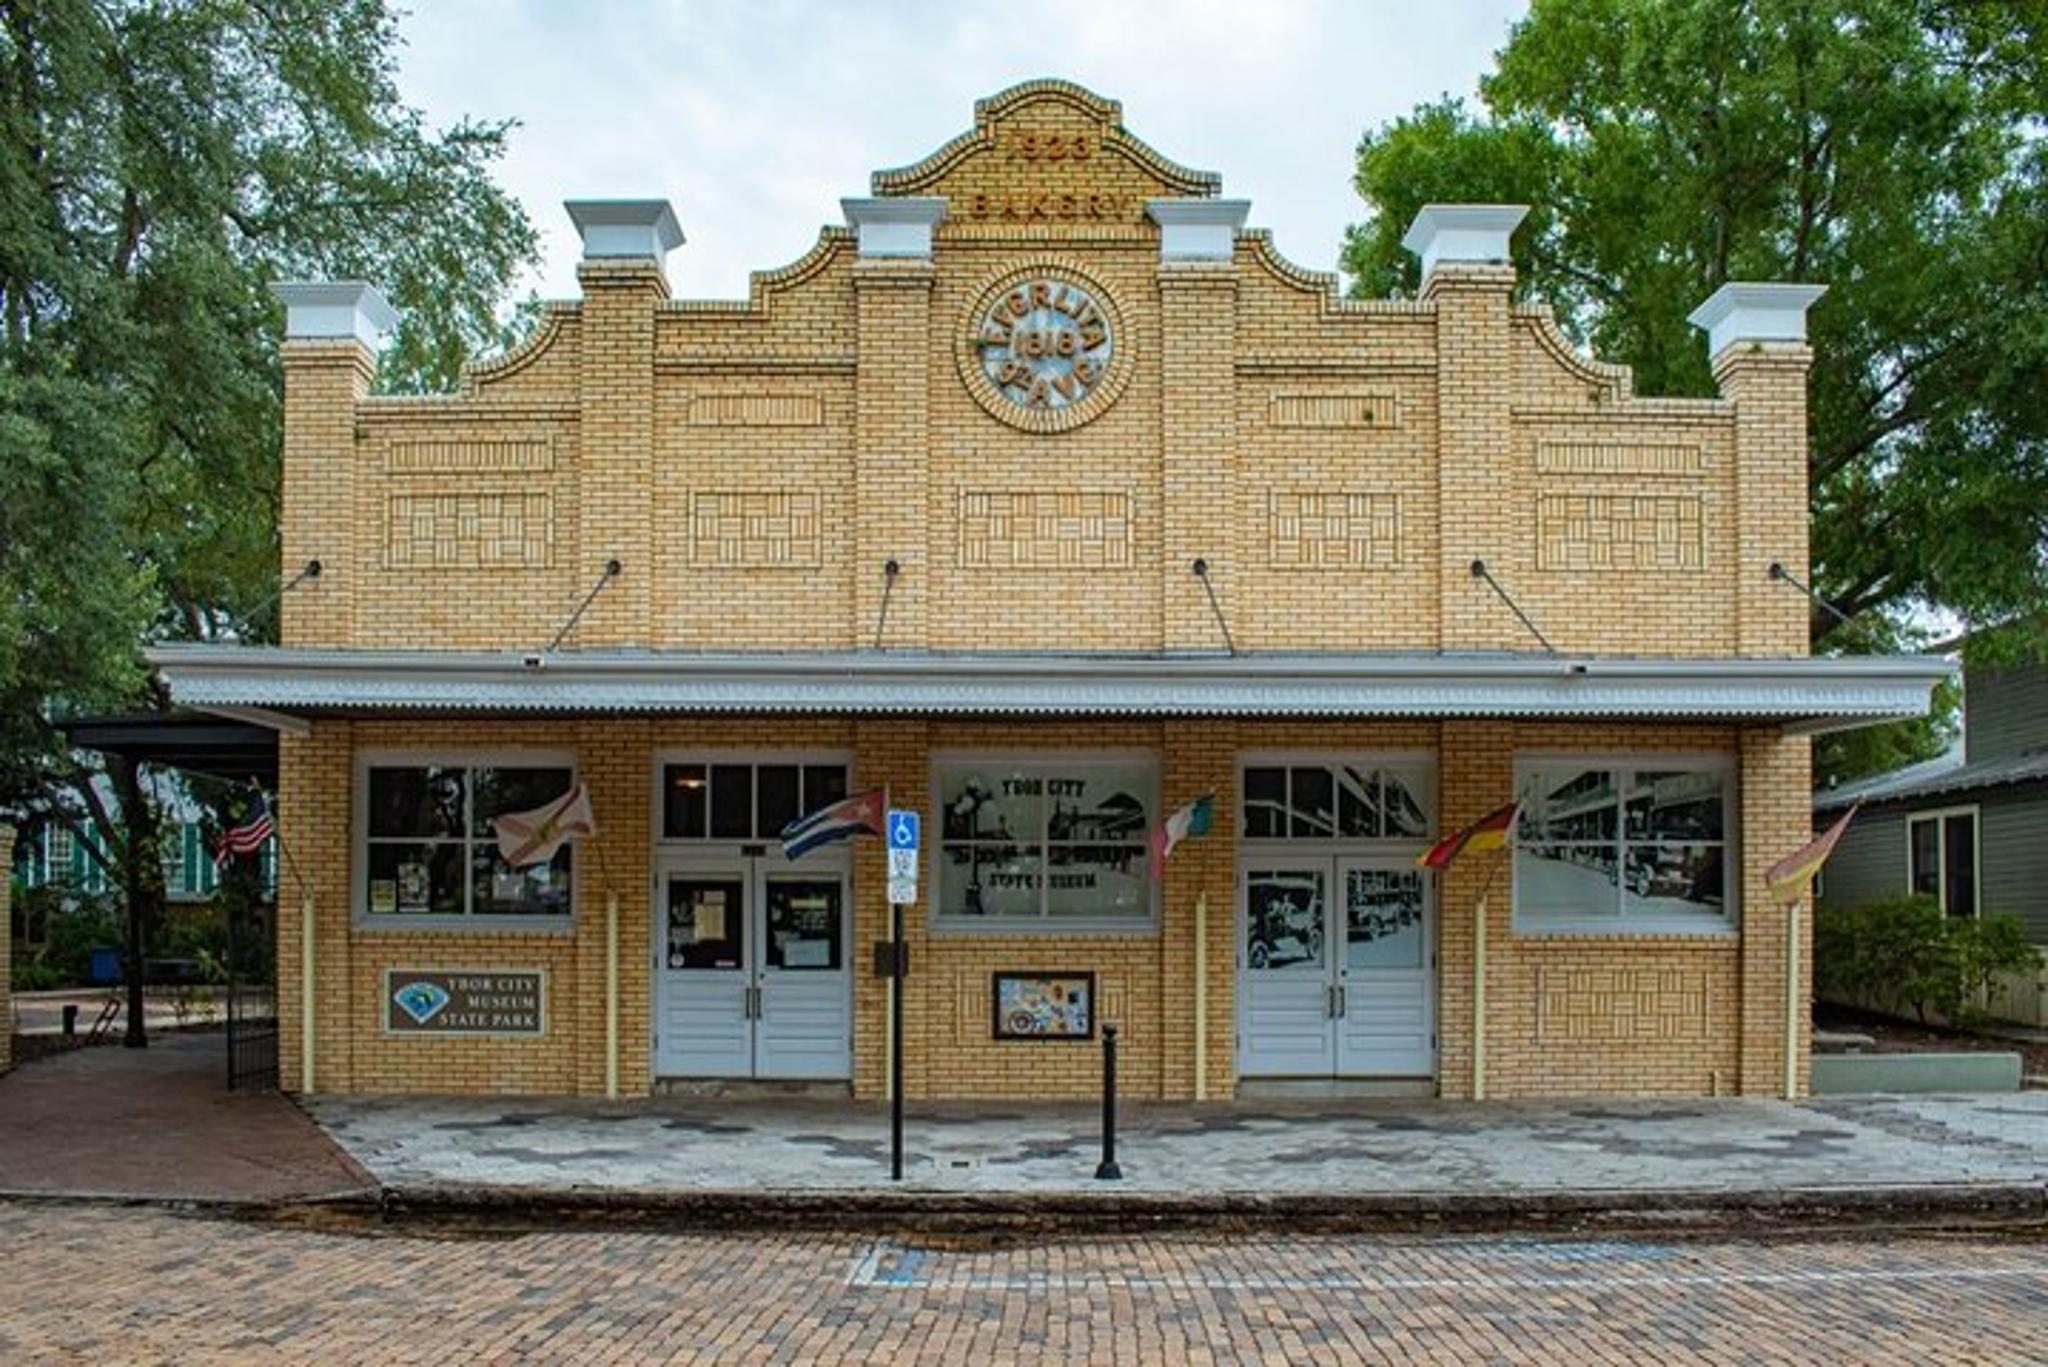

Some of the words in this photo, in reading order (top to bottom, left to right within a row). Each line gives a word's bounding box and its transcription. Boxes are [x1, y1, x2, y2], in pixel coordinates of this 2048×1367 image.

[971, 194, 1130, 220] BAKERY
[497, 978, 535, 991] CITY
[468, 995, 535, 1009] MUSEUM
[438, 1012, 489, 1027] STATE
[491, 1012, 536, 1027] PARK
